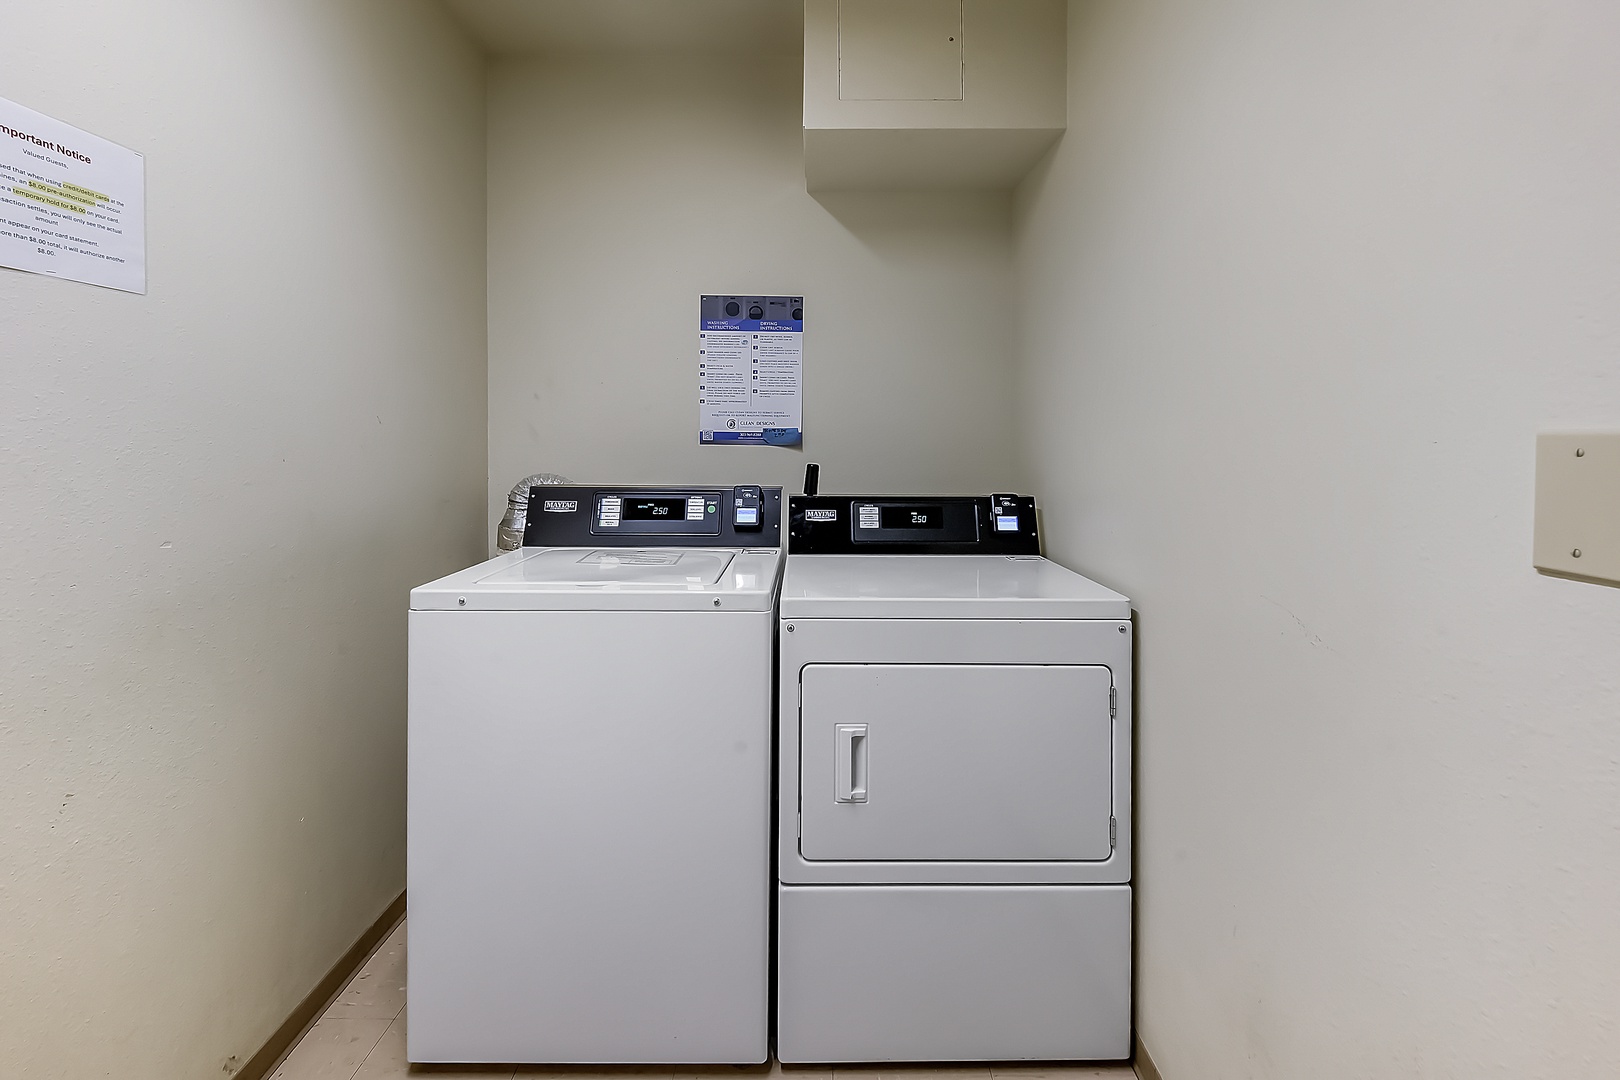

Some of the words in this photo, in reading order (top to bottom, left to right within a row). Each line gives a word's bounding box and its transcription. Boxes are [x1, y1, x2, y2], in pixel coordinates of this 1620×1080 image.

[22, 148, 45, 161] Valued
[45, 156, 69, 170] Guests,
[56, 143, 91, 164] Notice
[12, 166, 26, 175] that
[26, 171, 45, 181] when
[45, 178, 62, 188] using
[62, 183, 95, 198] credit/debit
[95, 194, 110, 203] cards
[28, 181, 46, 191] $8.00
[47, 188, 96, 207] pre-authorization
[12, 188, 46, 203] temporary
[46, 198, 60, 206] hold
[69, 204, 86, 214] $8.00
[94, 212, 107, 221] your
[26, 204, 50, 216] settles,
[50, 211, 62, 219] you
[73, 217, 86, 226] only
[106, 226, 123, 235] actual
[35, 216, 59, 226] amount
[7, 220, 31, 230] appear
[54, 231, 69, 239] card
[69, 235, 99, 247] statement.
[12, 233, 28, 241] than
[28, 236, 47, 246] $8.00
[46, 241, 63, 250] total,
[79, 249, 105, 259] authorize
[105, 255, 126, 264] another
[37, 247, 56, 257] $8.00.
